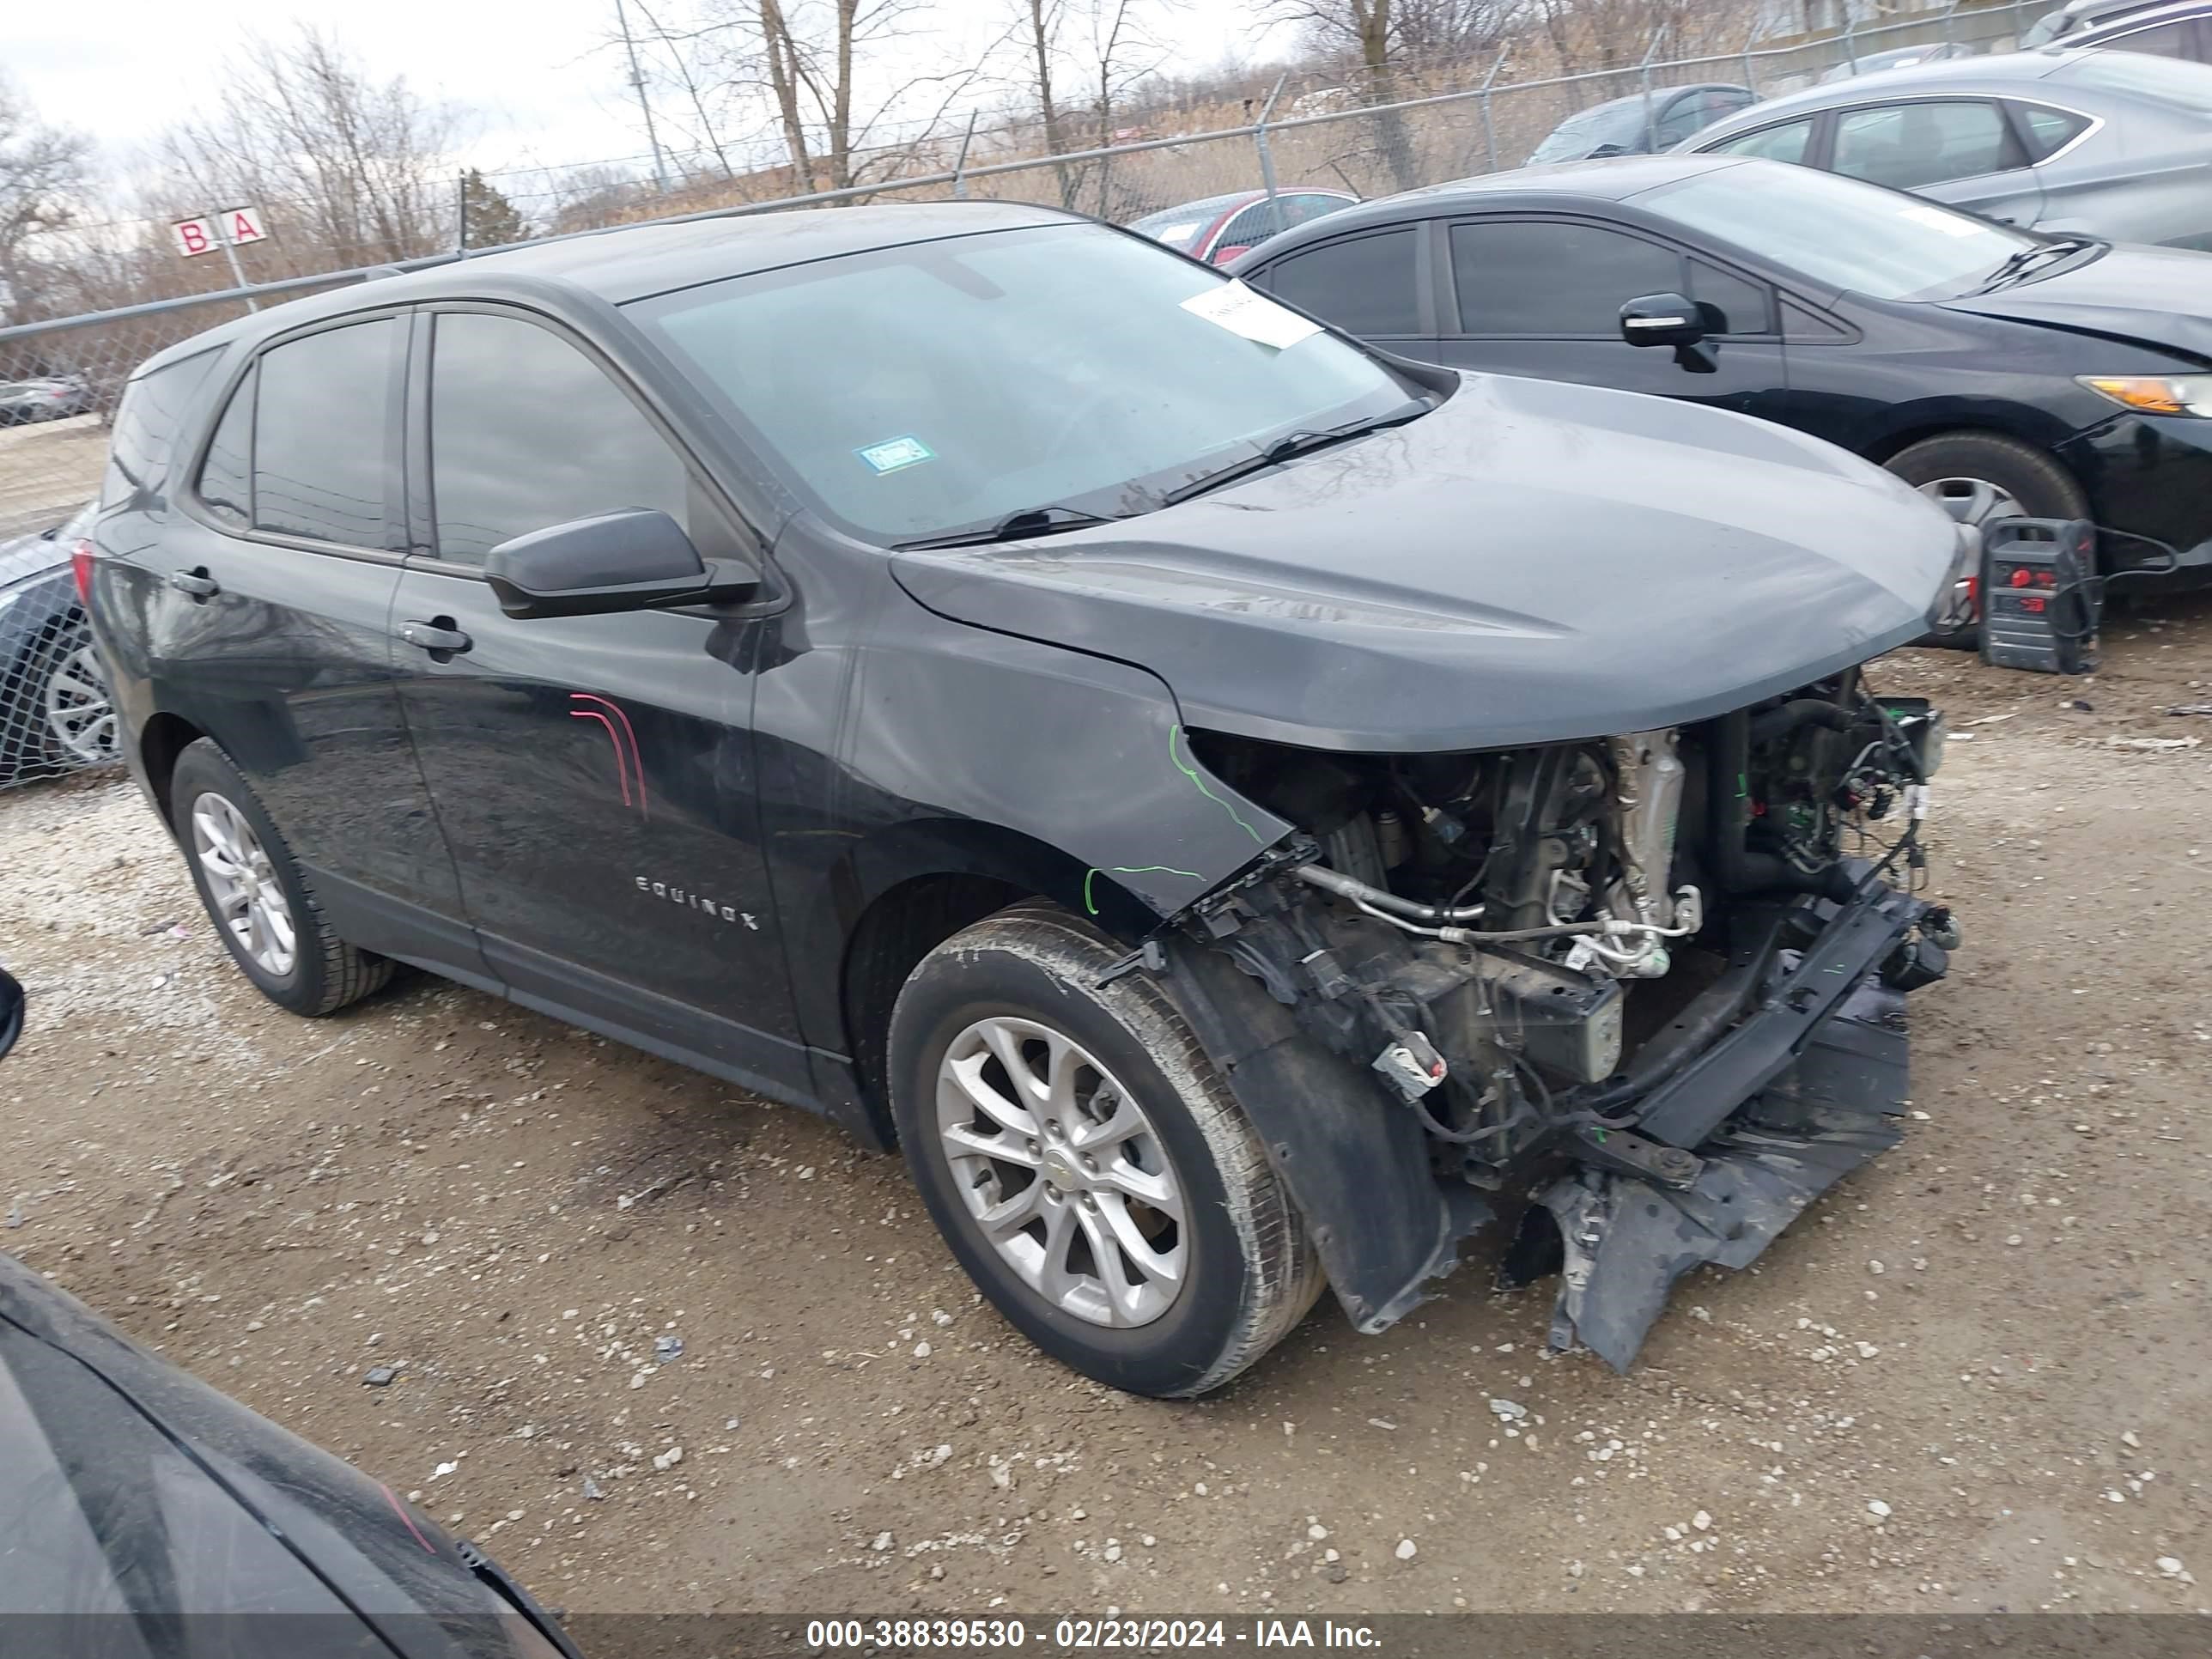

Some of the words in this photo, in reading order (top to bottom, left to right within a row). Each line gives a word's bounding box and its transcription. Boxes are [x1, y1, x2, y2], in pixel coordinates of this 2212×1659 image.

[180, 223, 207, 252] B
[235, 212, 259, 241] A
[635, 876, 761, 931] EQUINOX
